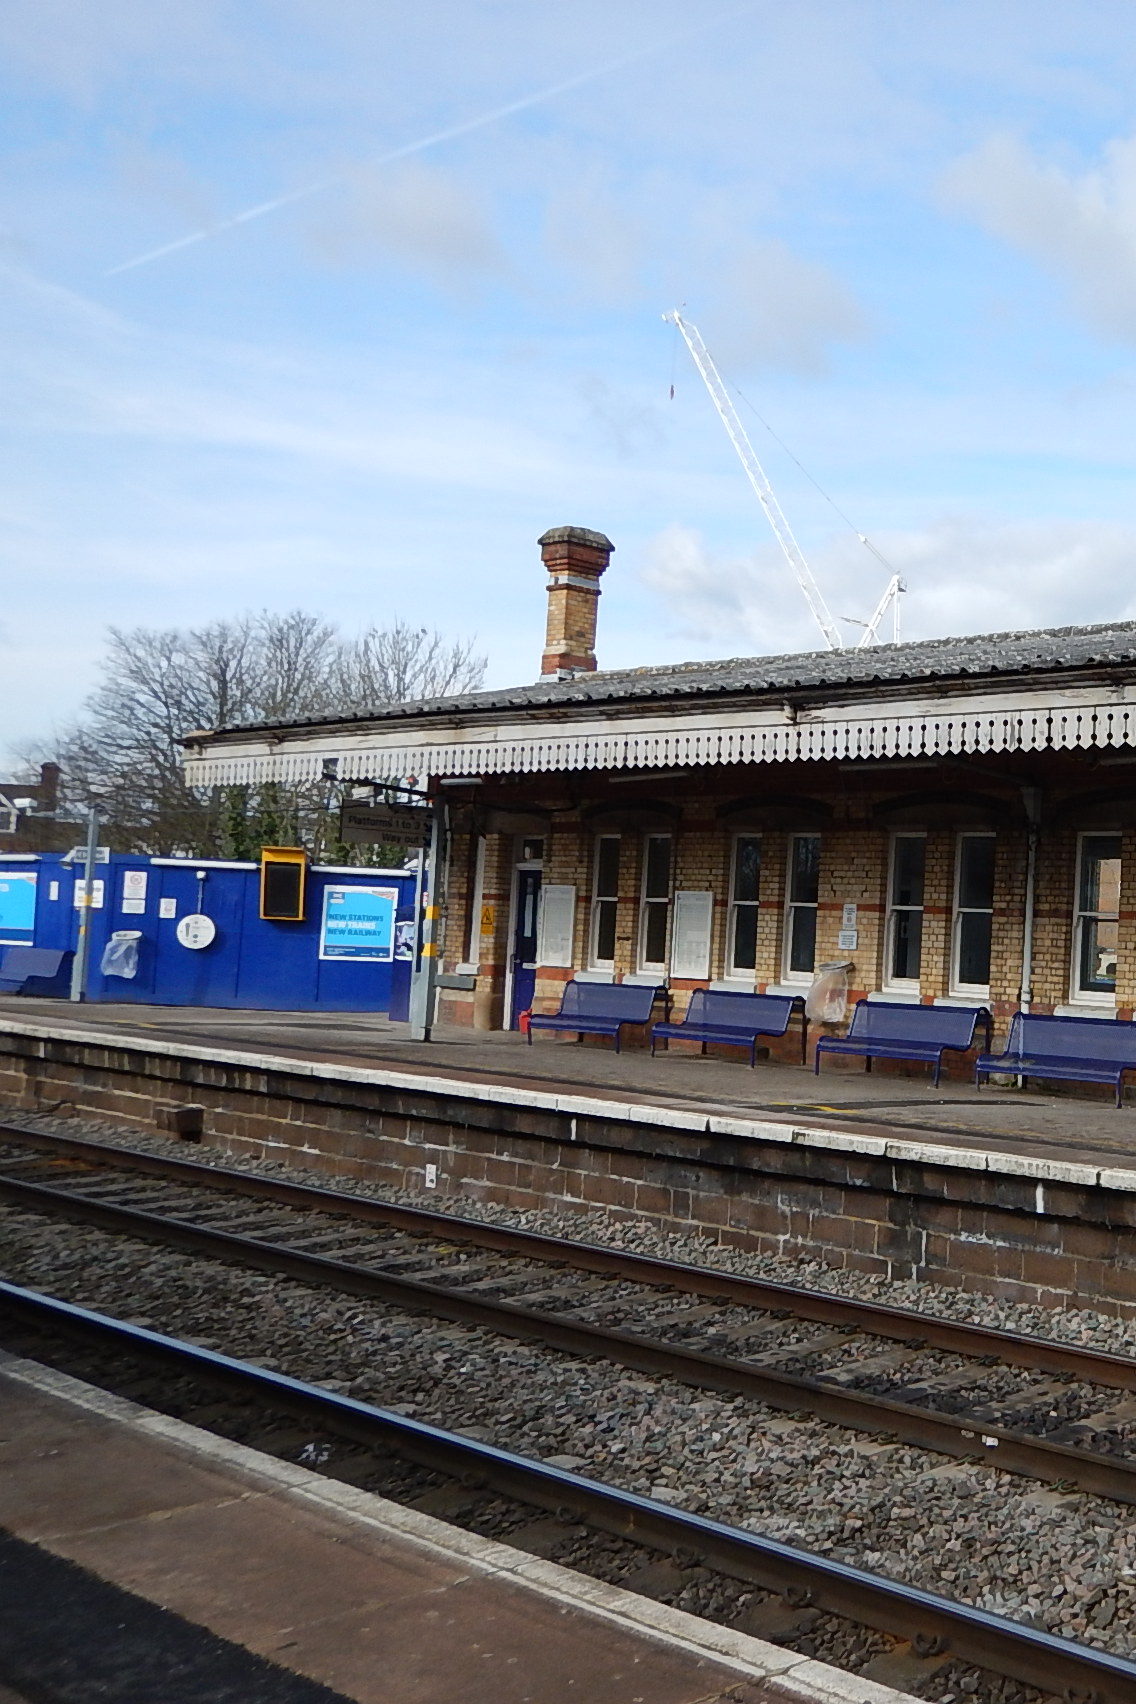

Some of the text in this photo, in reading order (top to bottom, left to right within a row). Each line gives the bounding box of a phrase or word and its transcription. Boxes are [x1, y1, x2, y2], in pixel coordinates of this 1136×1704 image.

[349, 816, 392, 827] Platforms
[402, 821, 411, 829] to
[382, 833, 401, 843] Way
[348, 914, 383, 922] STATIONS
[327, 928, 382, 937] NEW RAILWAY
